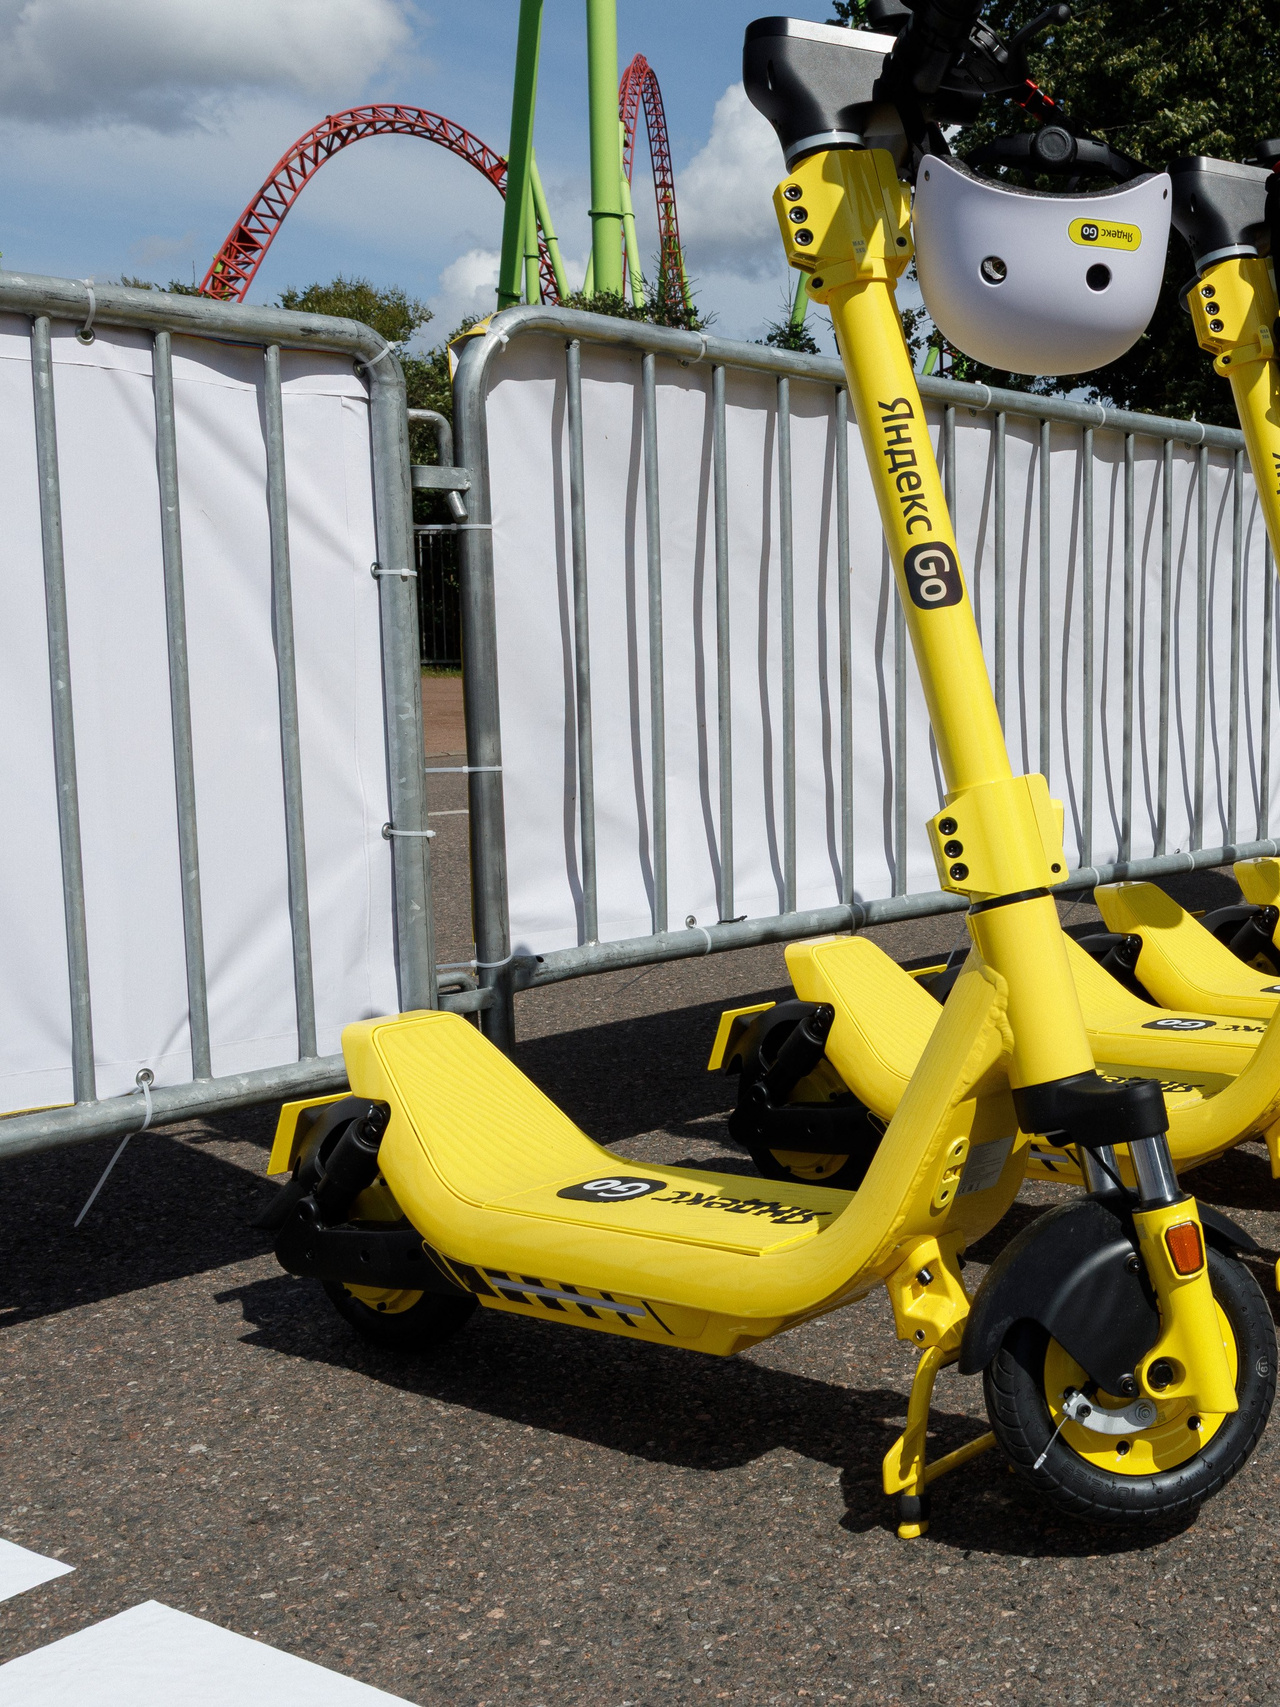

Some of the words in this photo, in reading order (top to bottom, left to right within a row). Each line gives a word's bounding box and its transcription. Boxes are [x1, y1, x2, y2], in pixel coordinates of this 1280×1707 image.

[1101, 228, 1133, 243] Яндекс
[877, 397, 932, 535] Яндекс
[914, 549, 950, 602] Go
[1156, 1019, 1206, 1029] Go
[582, 1179, 650, 1198] Go
[651, 1190, 833, 1225] Яндекс
